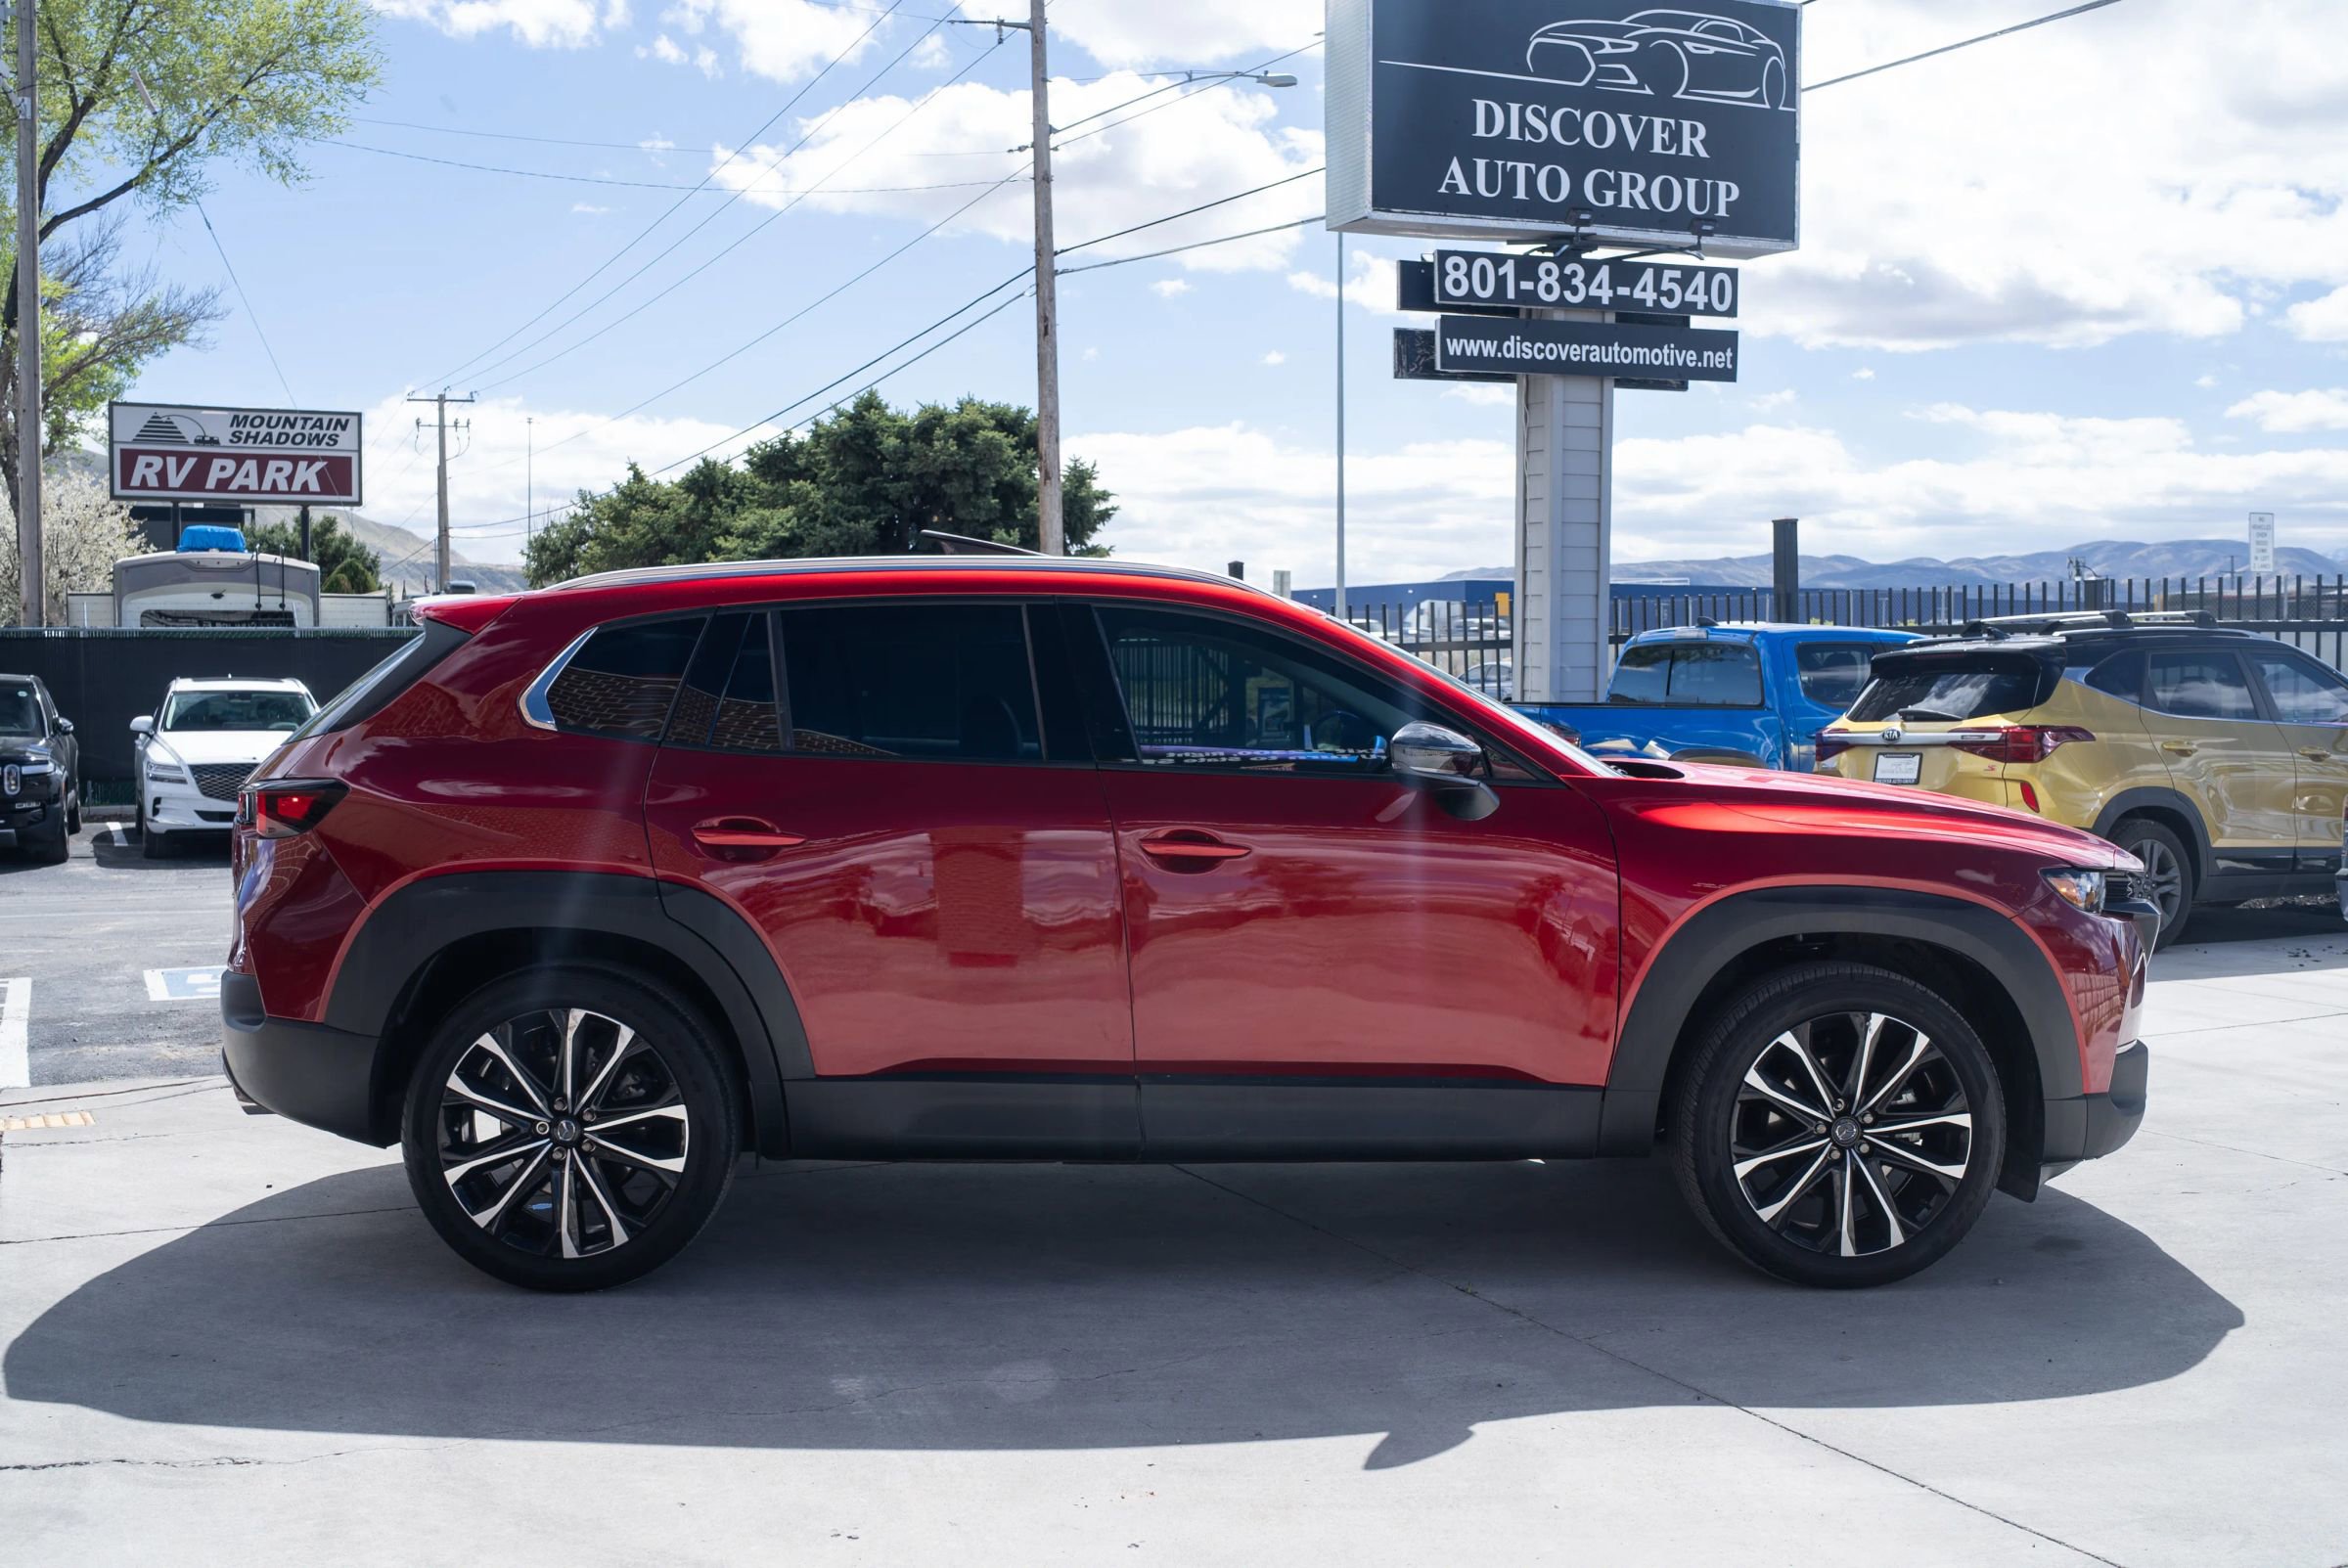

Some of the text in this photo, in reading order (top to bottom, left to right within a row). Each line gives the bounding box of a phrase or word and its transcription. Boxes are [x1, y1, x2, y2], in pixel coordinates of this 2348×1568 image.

[1471, 99, 1710, 158] DISCOVER
[1437, 156, 1740, 217] AUTO GROUP
[1444, 255, 1734, 313] 801-834-4540
[1446, 335, 1733, 370] www.discoverautomotive.net
[228, 430, 340, 447] SHADOWS
[229, 414, 350, 431] MOUNTAIN
[129, 455, 329, 493] RV PARK
[1884, 730, 1898, 739] KIA
